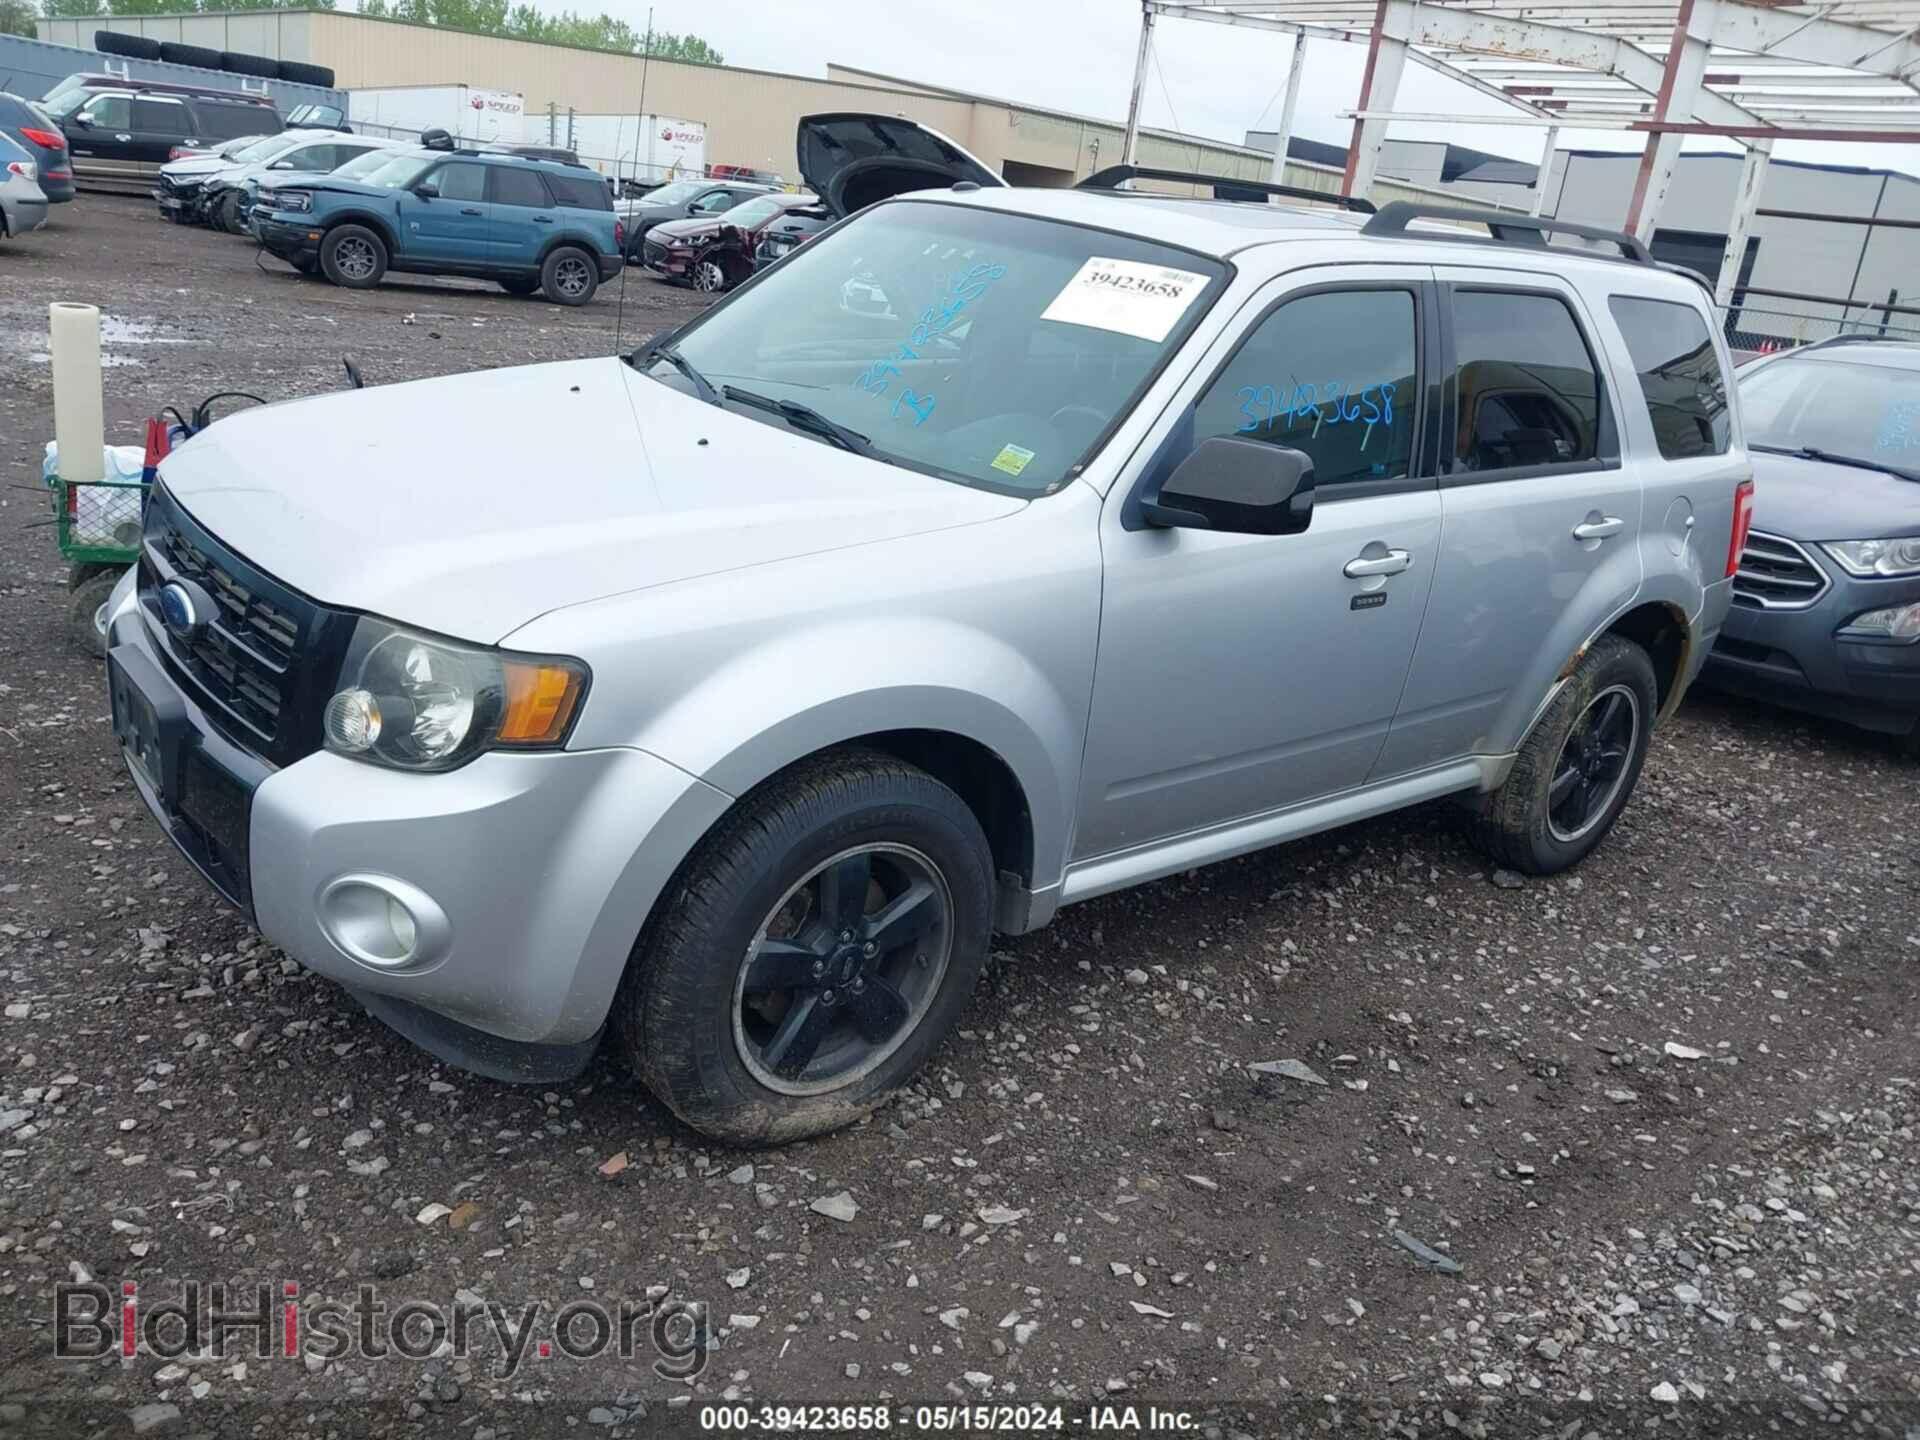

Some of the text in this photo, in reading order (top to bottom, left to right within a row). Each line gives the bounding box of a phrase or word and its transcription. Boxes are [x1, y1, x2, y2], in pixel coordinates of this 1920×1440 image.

[487, 99, 521, 113] SPEED
[673, 131, 704, 144] SPEED
[1083, 271, 1183, 298] 39423658
[1238, 382, 1396, 431] 39423658
